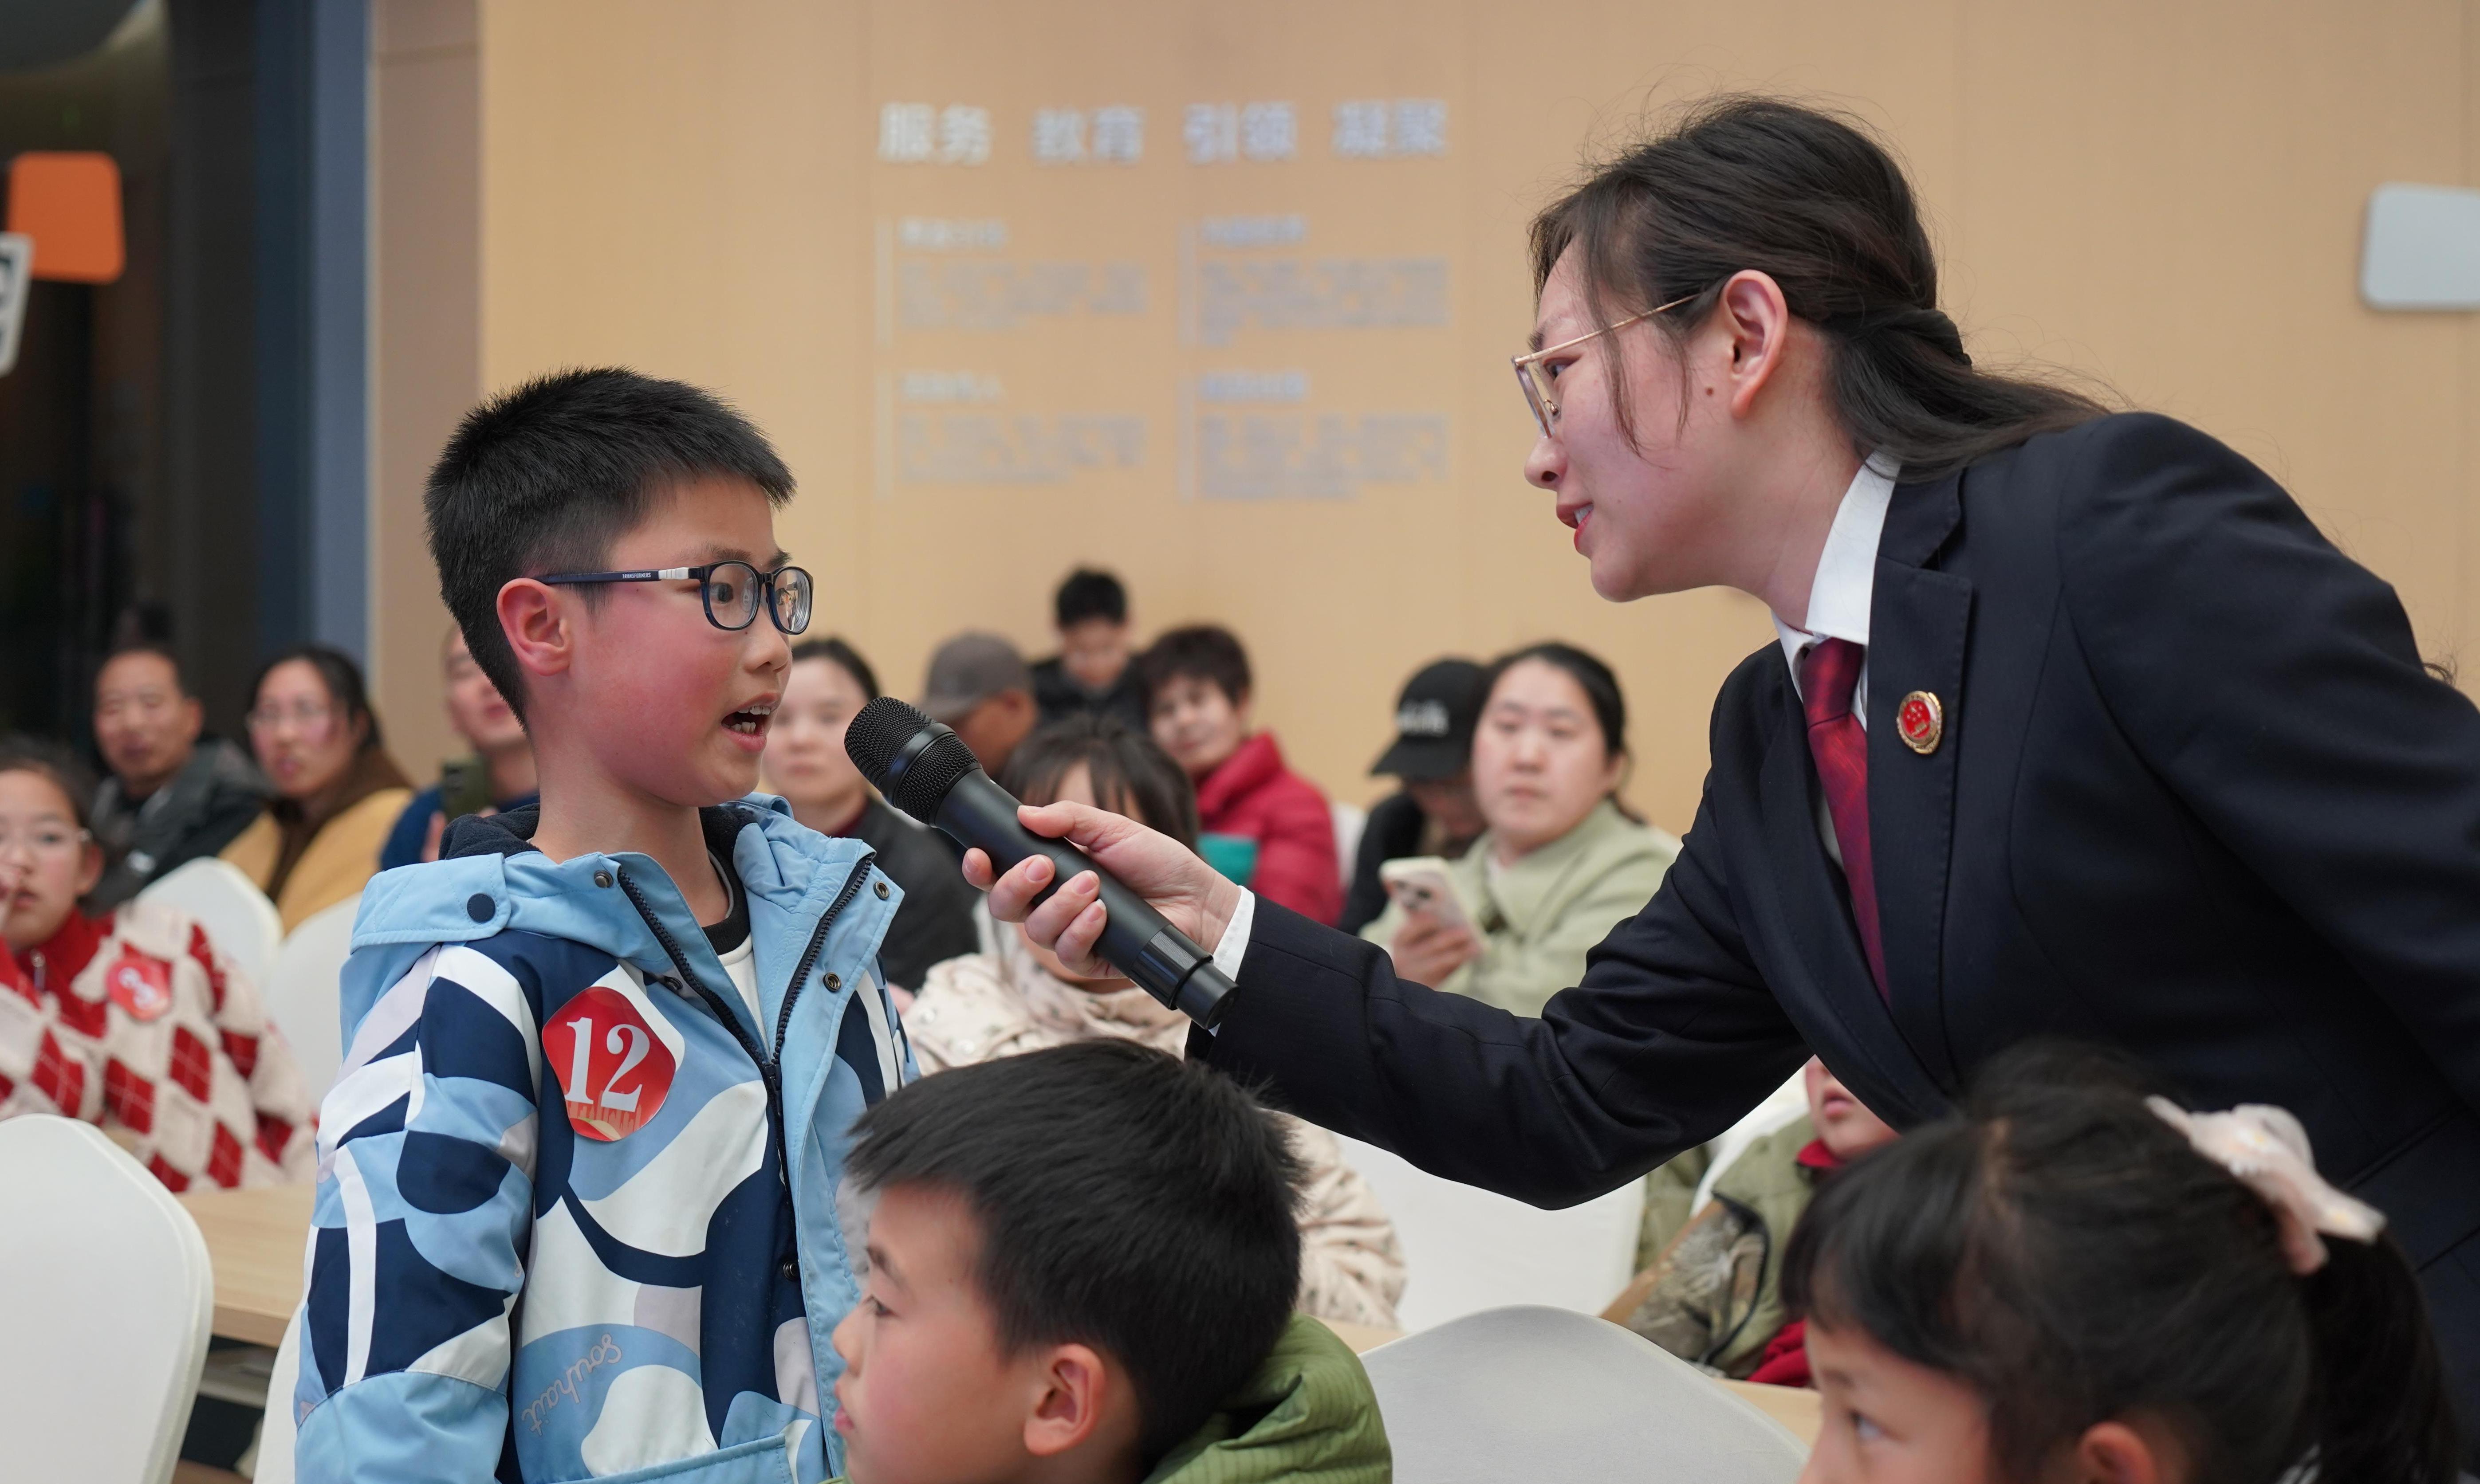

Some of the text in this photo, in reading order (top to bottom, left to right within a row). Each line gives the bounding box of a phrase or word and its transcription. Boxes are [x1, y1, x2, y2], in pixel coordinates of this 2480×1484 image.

[880, 104, 991, 162] 服务
[1031, 106, 1145, 163] 教育
[1183, 103, 1296, 162] 引领
[564, 1017, 650, 1112] 12
[521, 1333, 622, 1437] souhait
